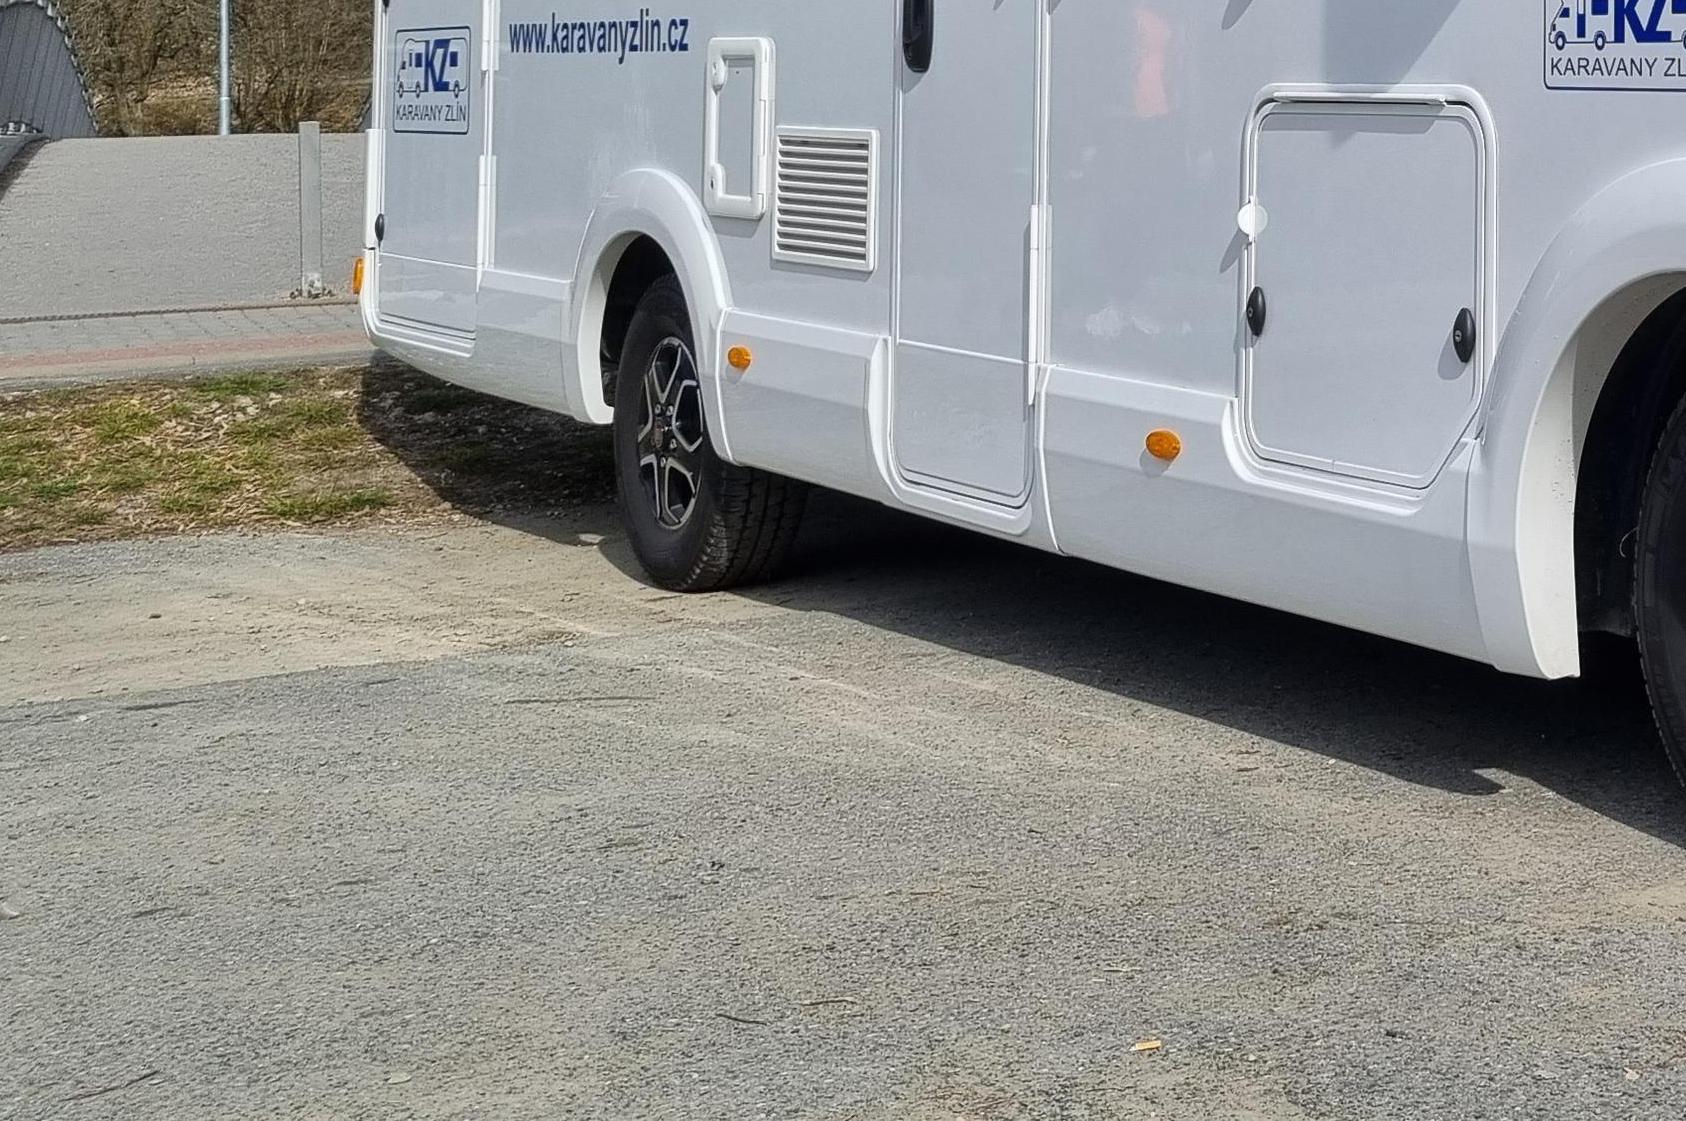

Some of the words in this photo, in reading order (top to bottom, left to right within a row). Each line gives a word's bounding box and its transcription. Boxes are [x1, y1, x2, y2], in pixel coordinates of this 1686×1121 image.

[509, 8, 689, 65] www.karavanyzlin.cz
[423, 38, 452, 93] KZ
[1550, 56, 1658, 78] KARAVANY
[395, 104, 443, 121] KARAVANY
[444, 100, 467, 122] ZLÍN
